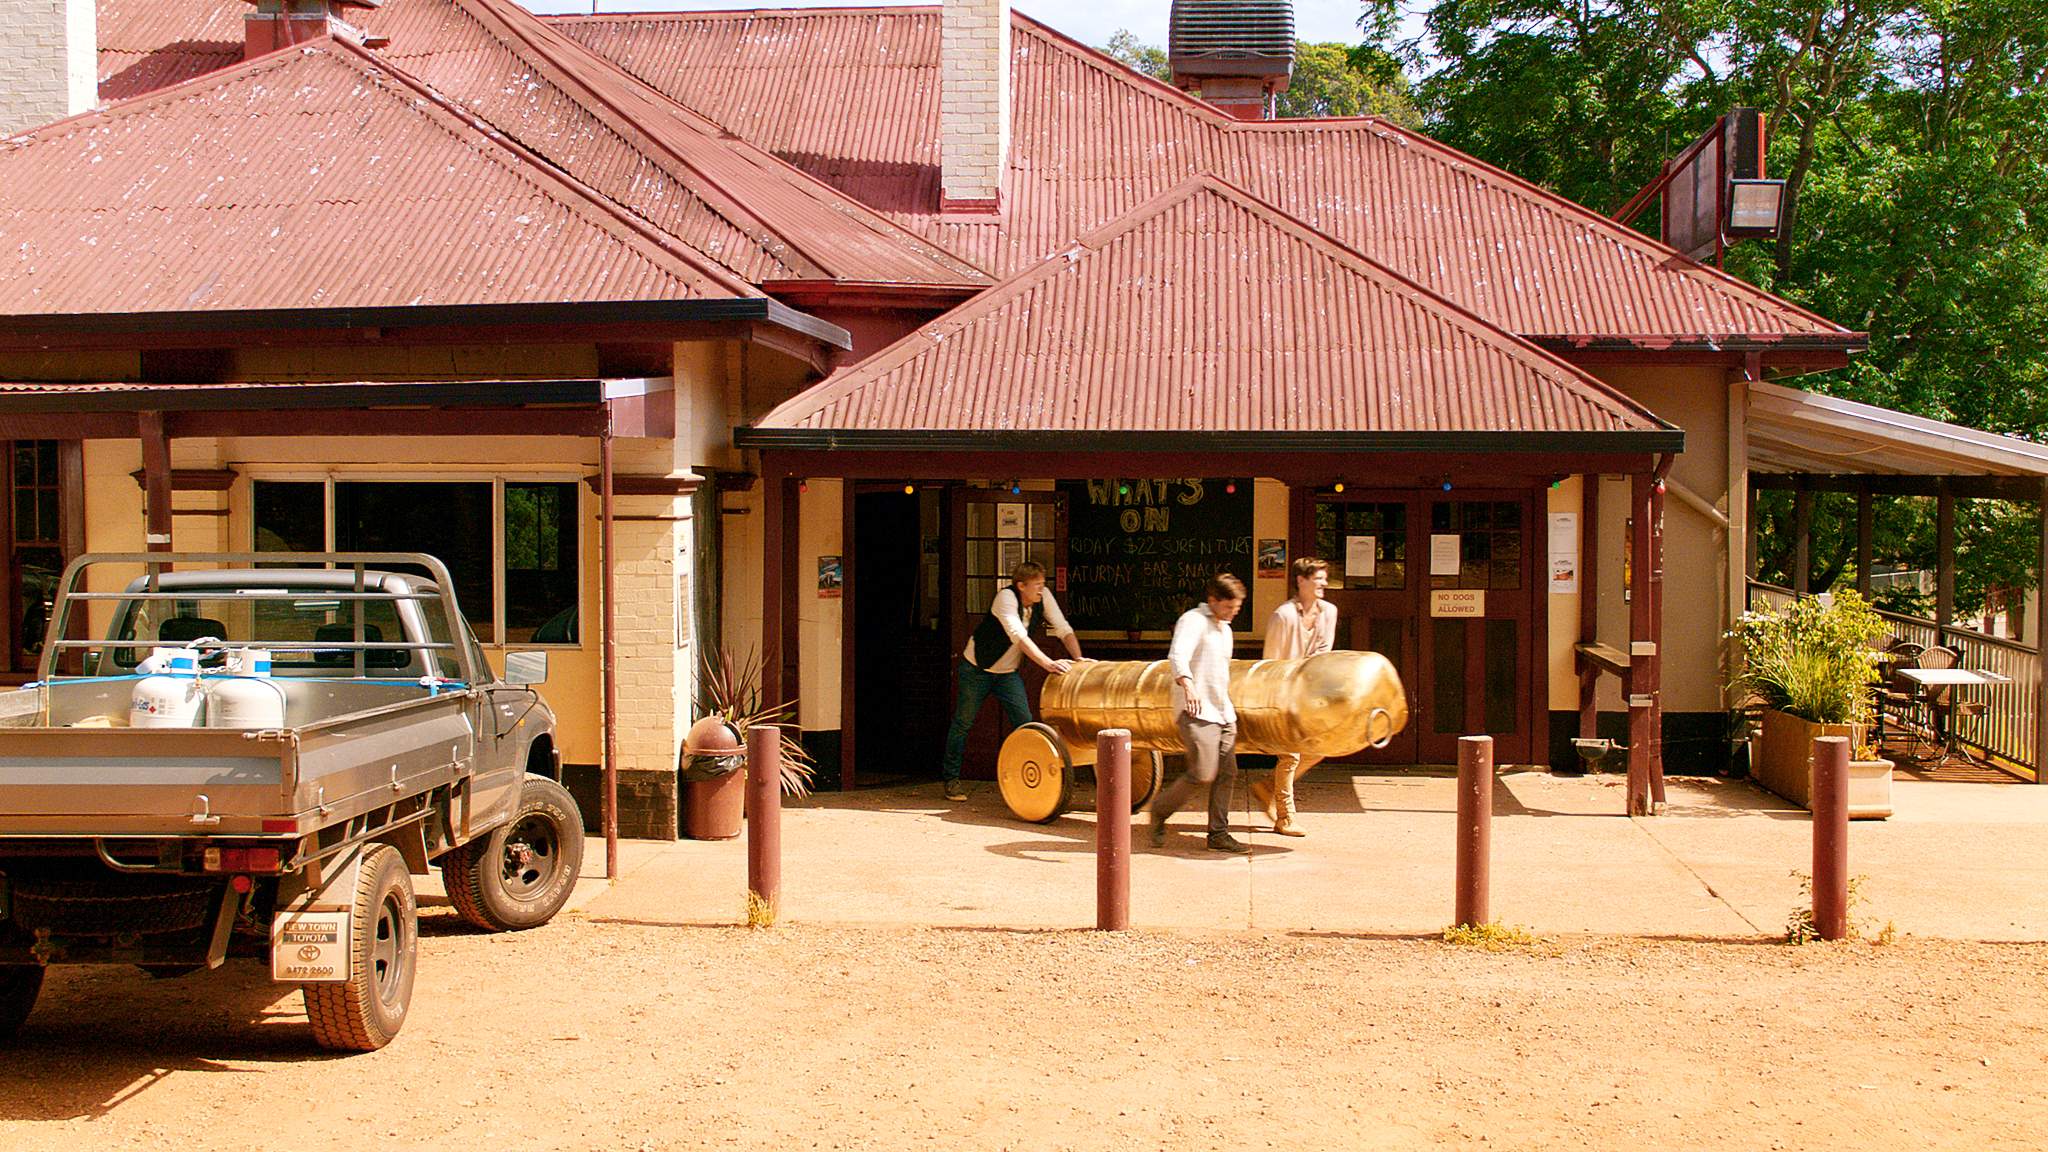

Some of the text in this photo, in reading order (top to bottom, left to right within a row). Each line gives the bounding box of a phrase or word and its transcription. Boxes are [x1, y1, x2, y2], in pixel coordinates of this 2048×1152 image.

[1086, 478, 1204, 506] WHAT'S
[1120, 507, 1170, 532] ON
[1068, 535, 1253, 555] RIDAY $22 SURF N TURF
[1143, 560, 1174, 578] BAR
[1177, 562, 1232, 578] SNACKS
[1437, 593, 1475, 601] NO DOGS
[1437, 605, 1475, 613] ALLOWED
[285, 922, 337, 932] NEW TOWN
[292, 933, 329, 943] TOYOTA
